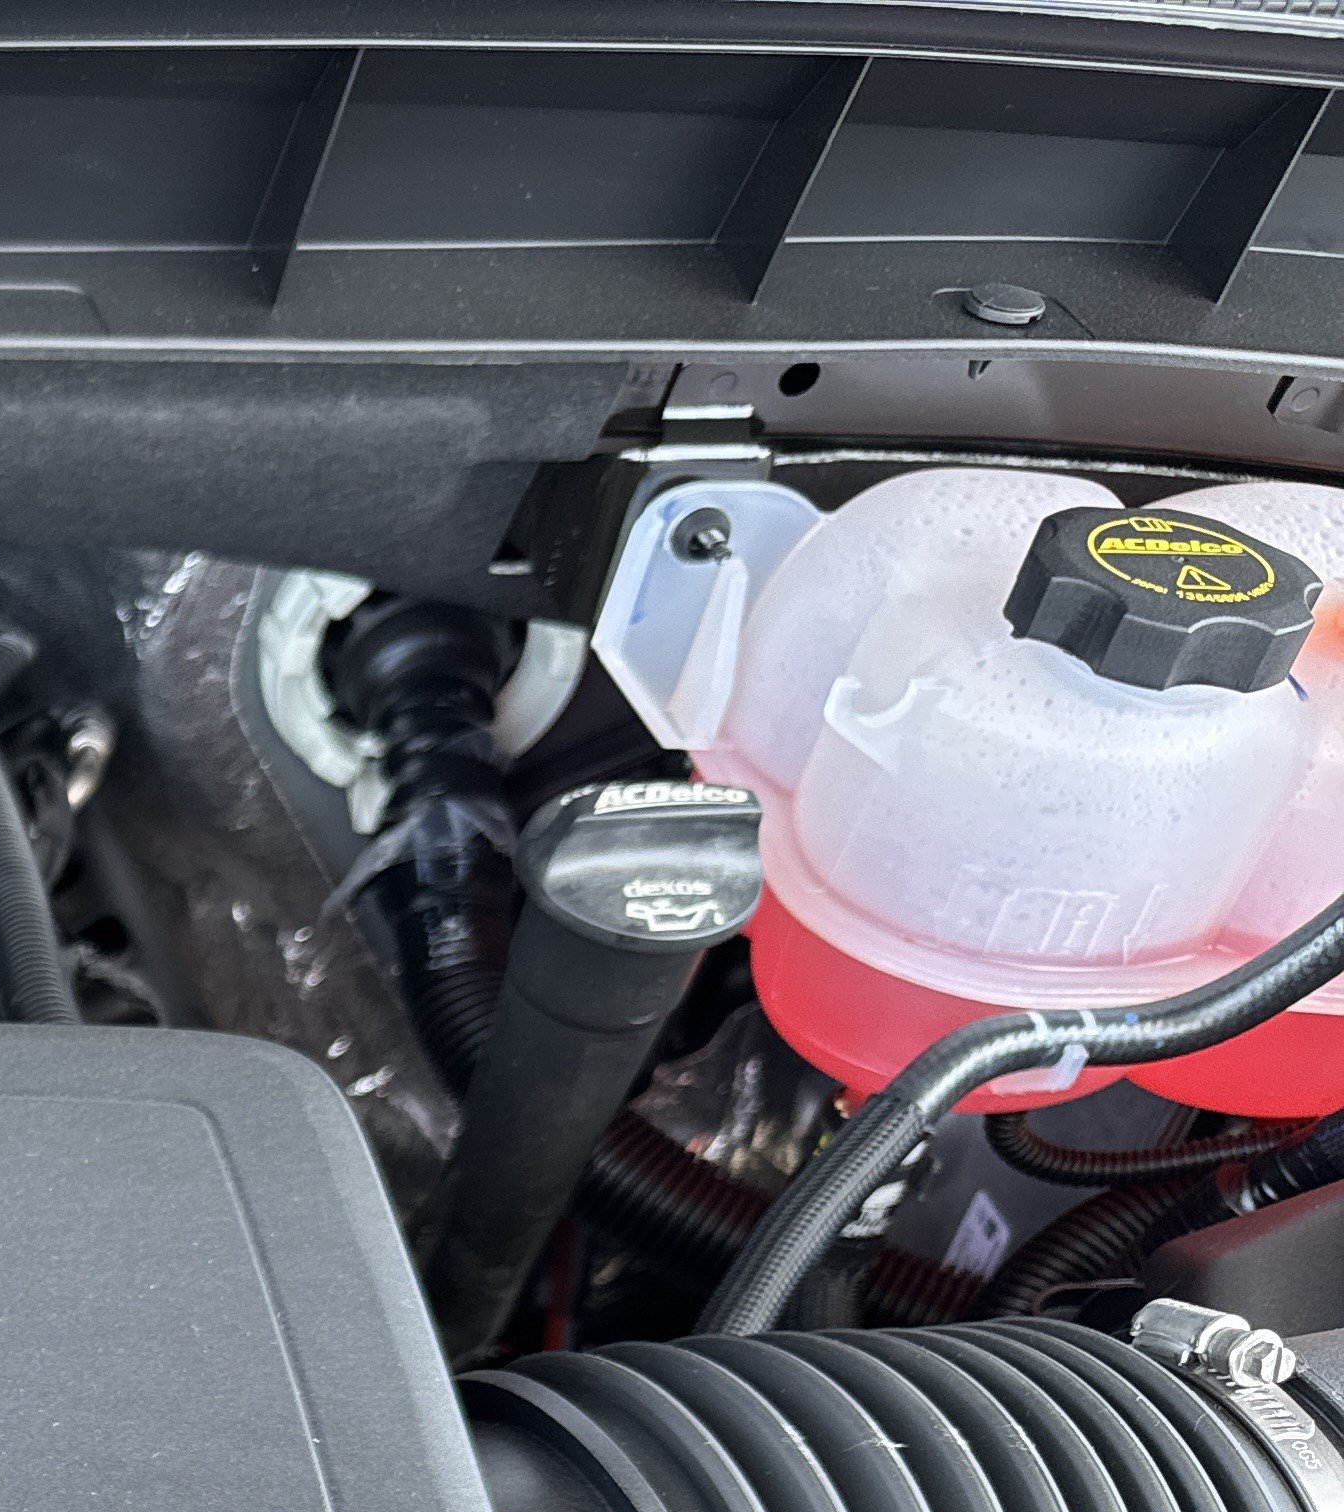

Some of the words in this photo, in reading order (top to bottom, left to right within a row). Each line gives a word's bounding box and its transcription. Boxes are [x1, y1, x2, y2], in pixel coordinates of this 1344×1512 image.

[1097, 537, 1244, 554] ACDelco
[595, 783, 749, 811] ACDelco
[623, 879, 713, 898] dexos
